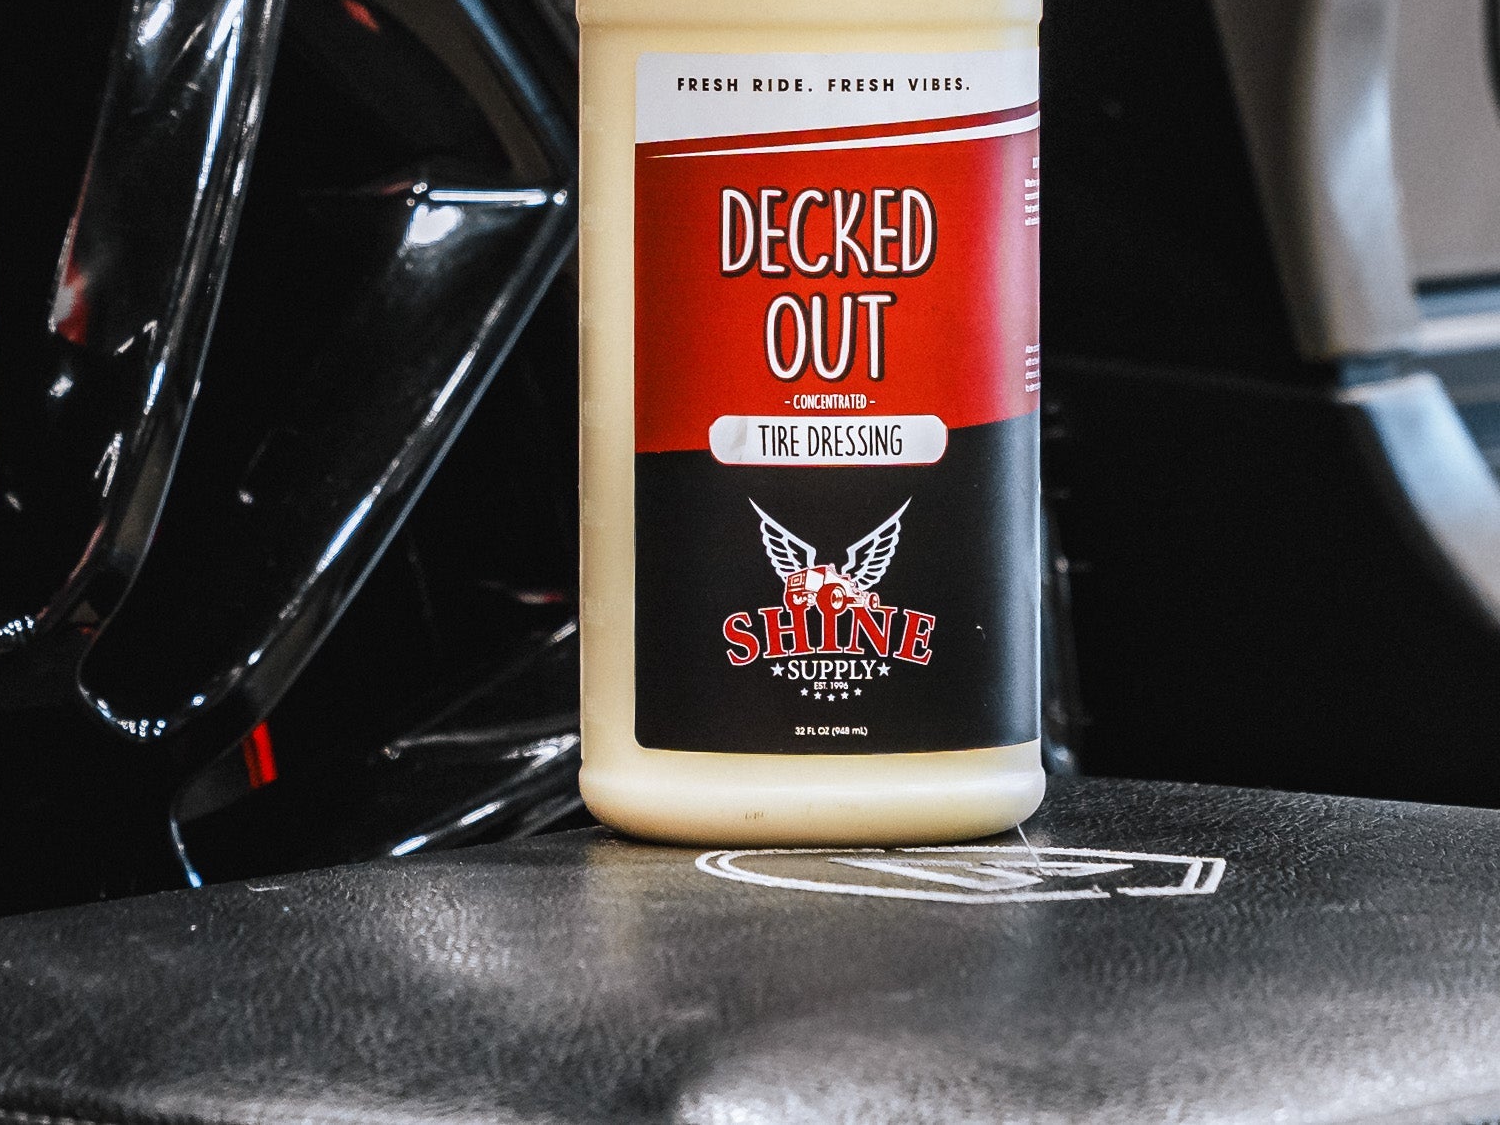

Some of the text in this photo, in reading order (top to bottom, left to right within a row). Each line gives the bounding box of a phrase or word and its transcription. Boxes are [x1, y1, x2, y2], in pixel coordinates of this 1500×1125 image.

[677, 77, 970, 93] FRESH RIDE. FRESH VIBES.
[719, 186, 938, 277] DECKED
[764, 292, 897, 382] OUT
[758, 424, 903, 457] TIRE DRESSING
[721, 604, 936, 666] SHINE
[787, 659, 877, 680] SUPPLY
[814, 682, 849, 690] EST. 1996
[795, 727, 805, 735] 32
[807, 727, 816, 735] FL
[818, 727, 829, 735] OZ
[852, 727, 868, 736] mL)
